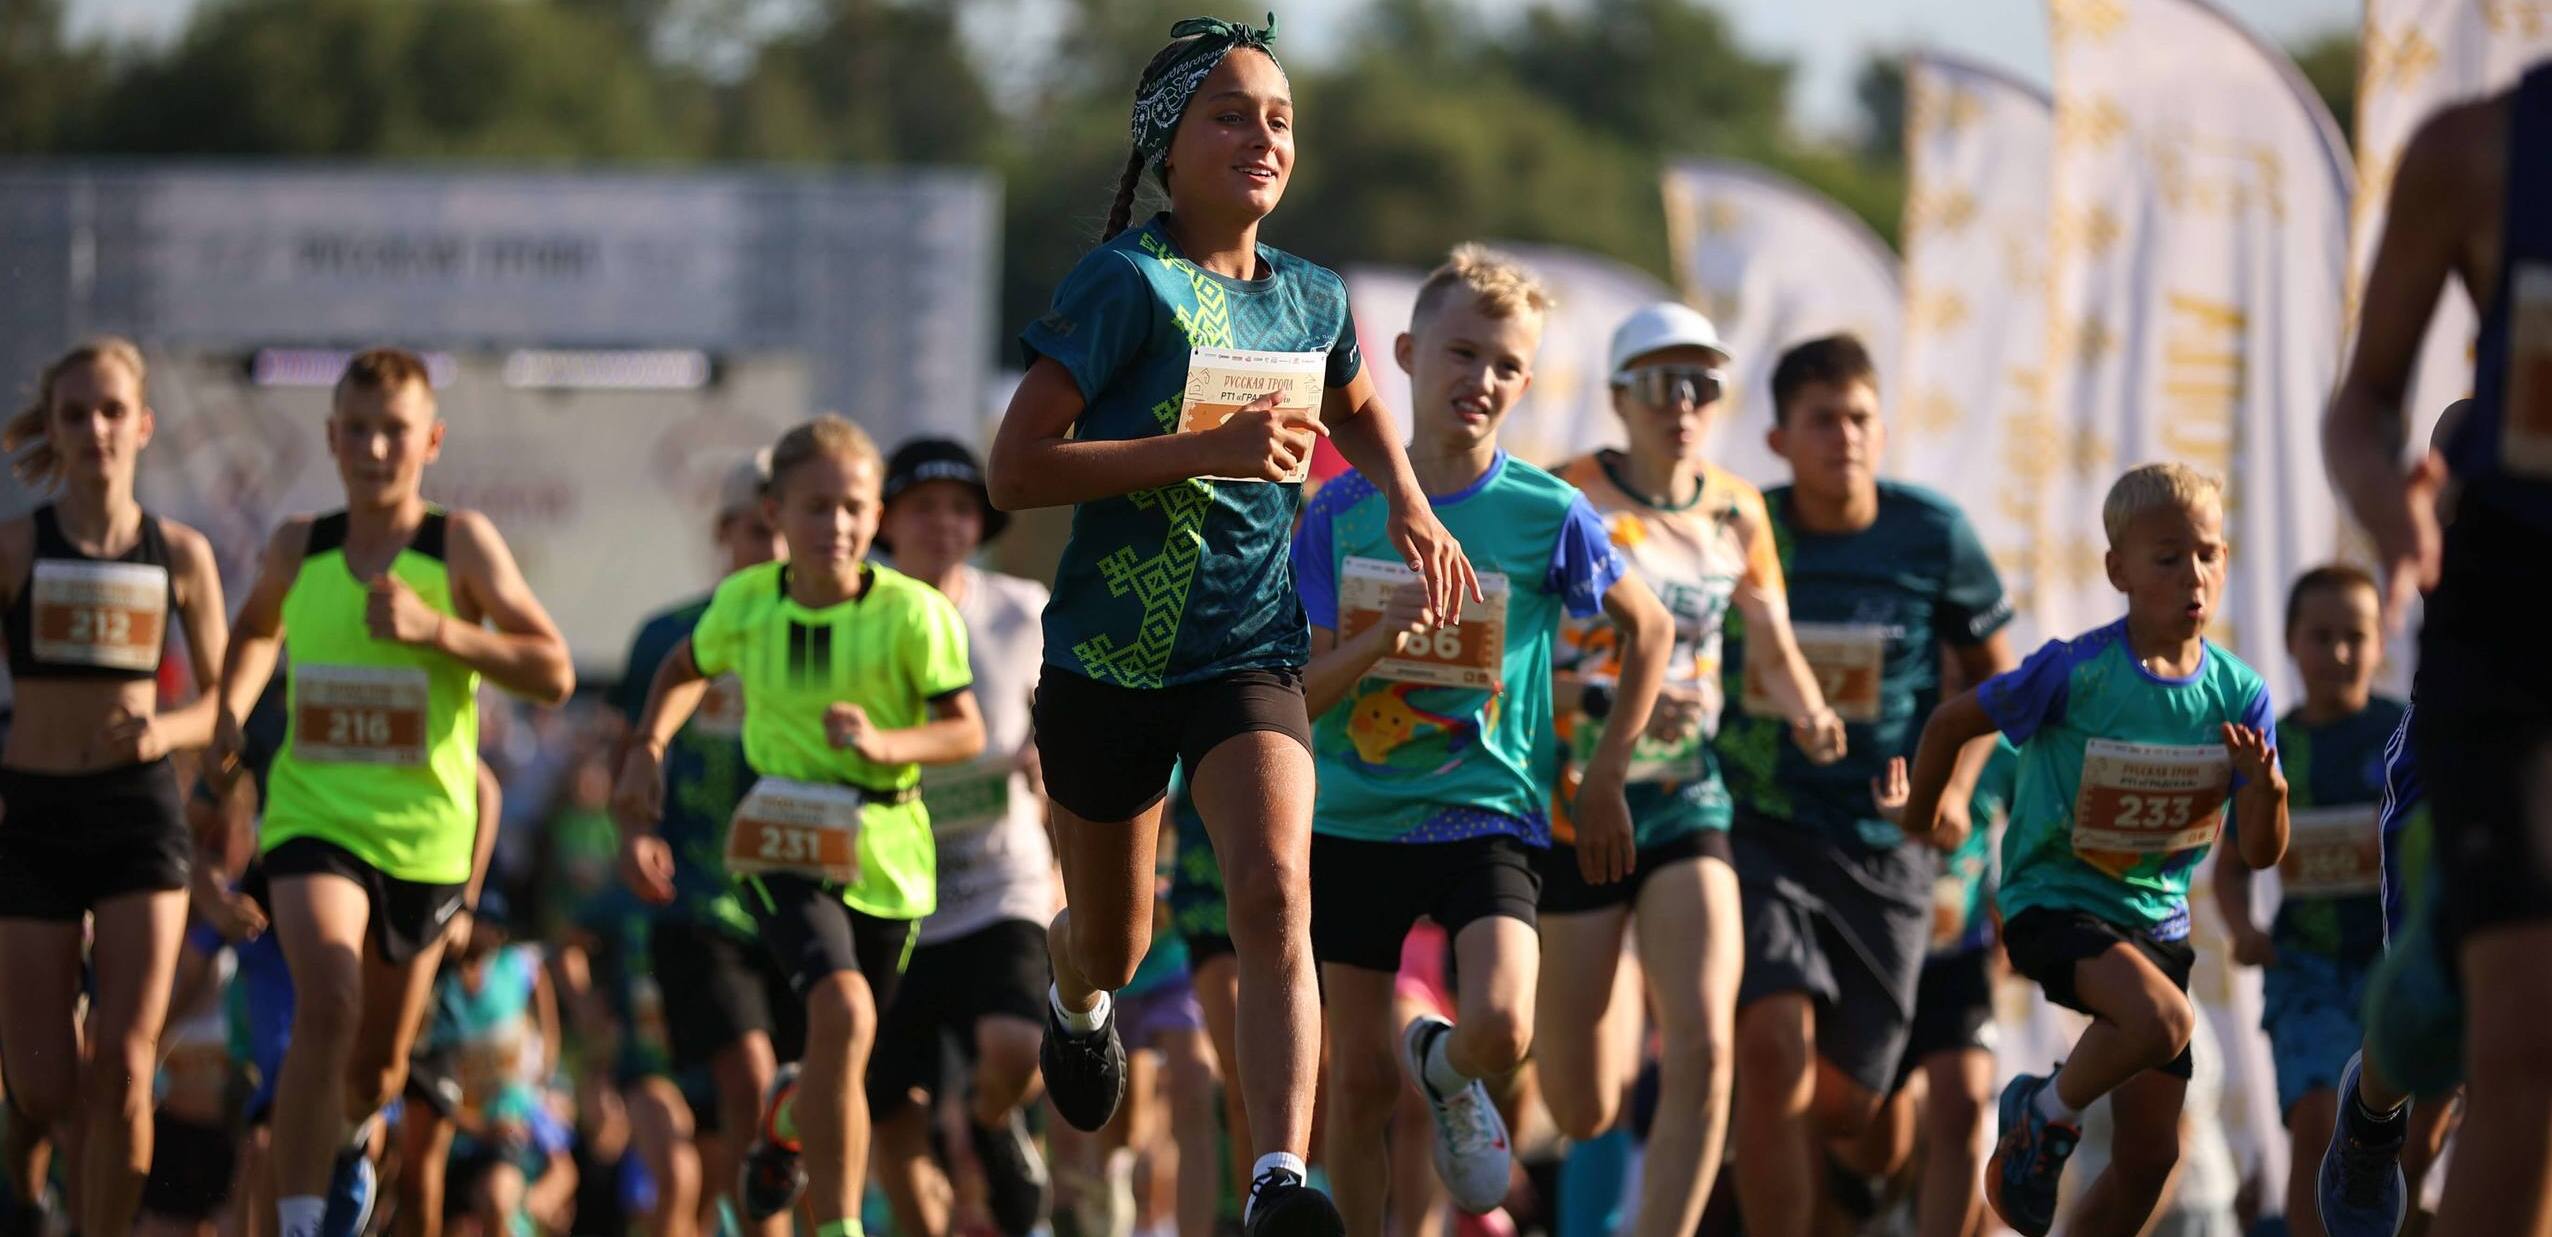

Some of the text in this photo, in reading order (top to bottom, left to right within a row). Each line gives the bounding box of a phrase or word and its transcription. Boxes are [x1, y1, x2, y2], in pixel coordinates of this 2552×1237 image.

[1224, 375, 1294, 391] РУССКАЯ ТРОПА
[329, 713, 391, 742] 216
[2114, 794, 2193, 829] 233
[759, 826, 818, 860] 231
